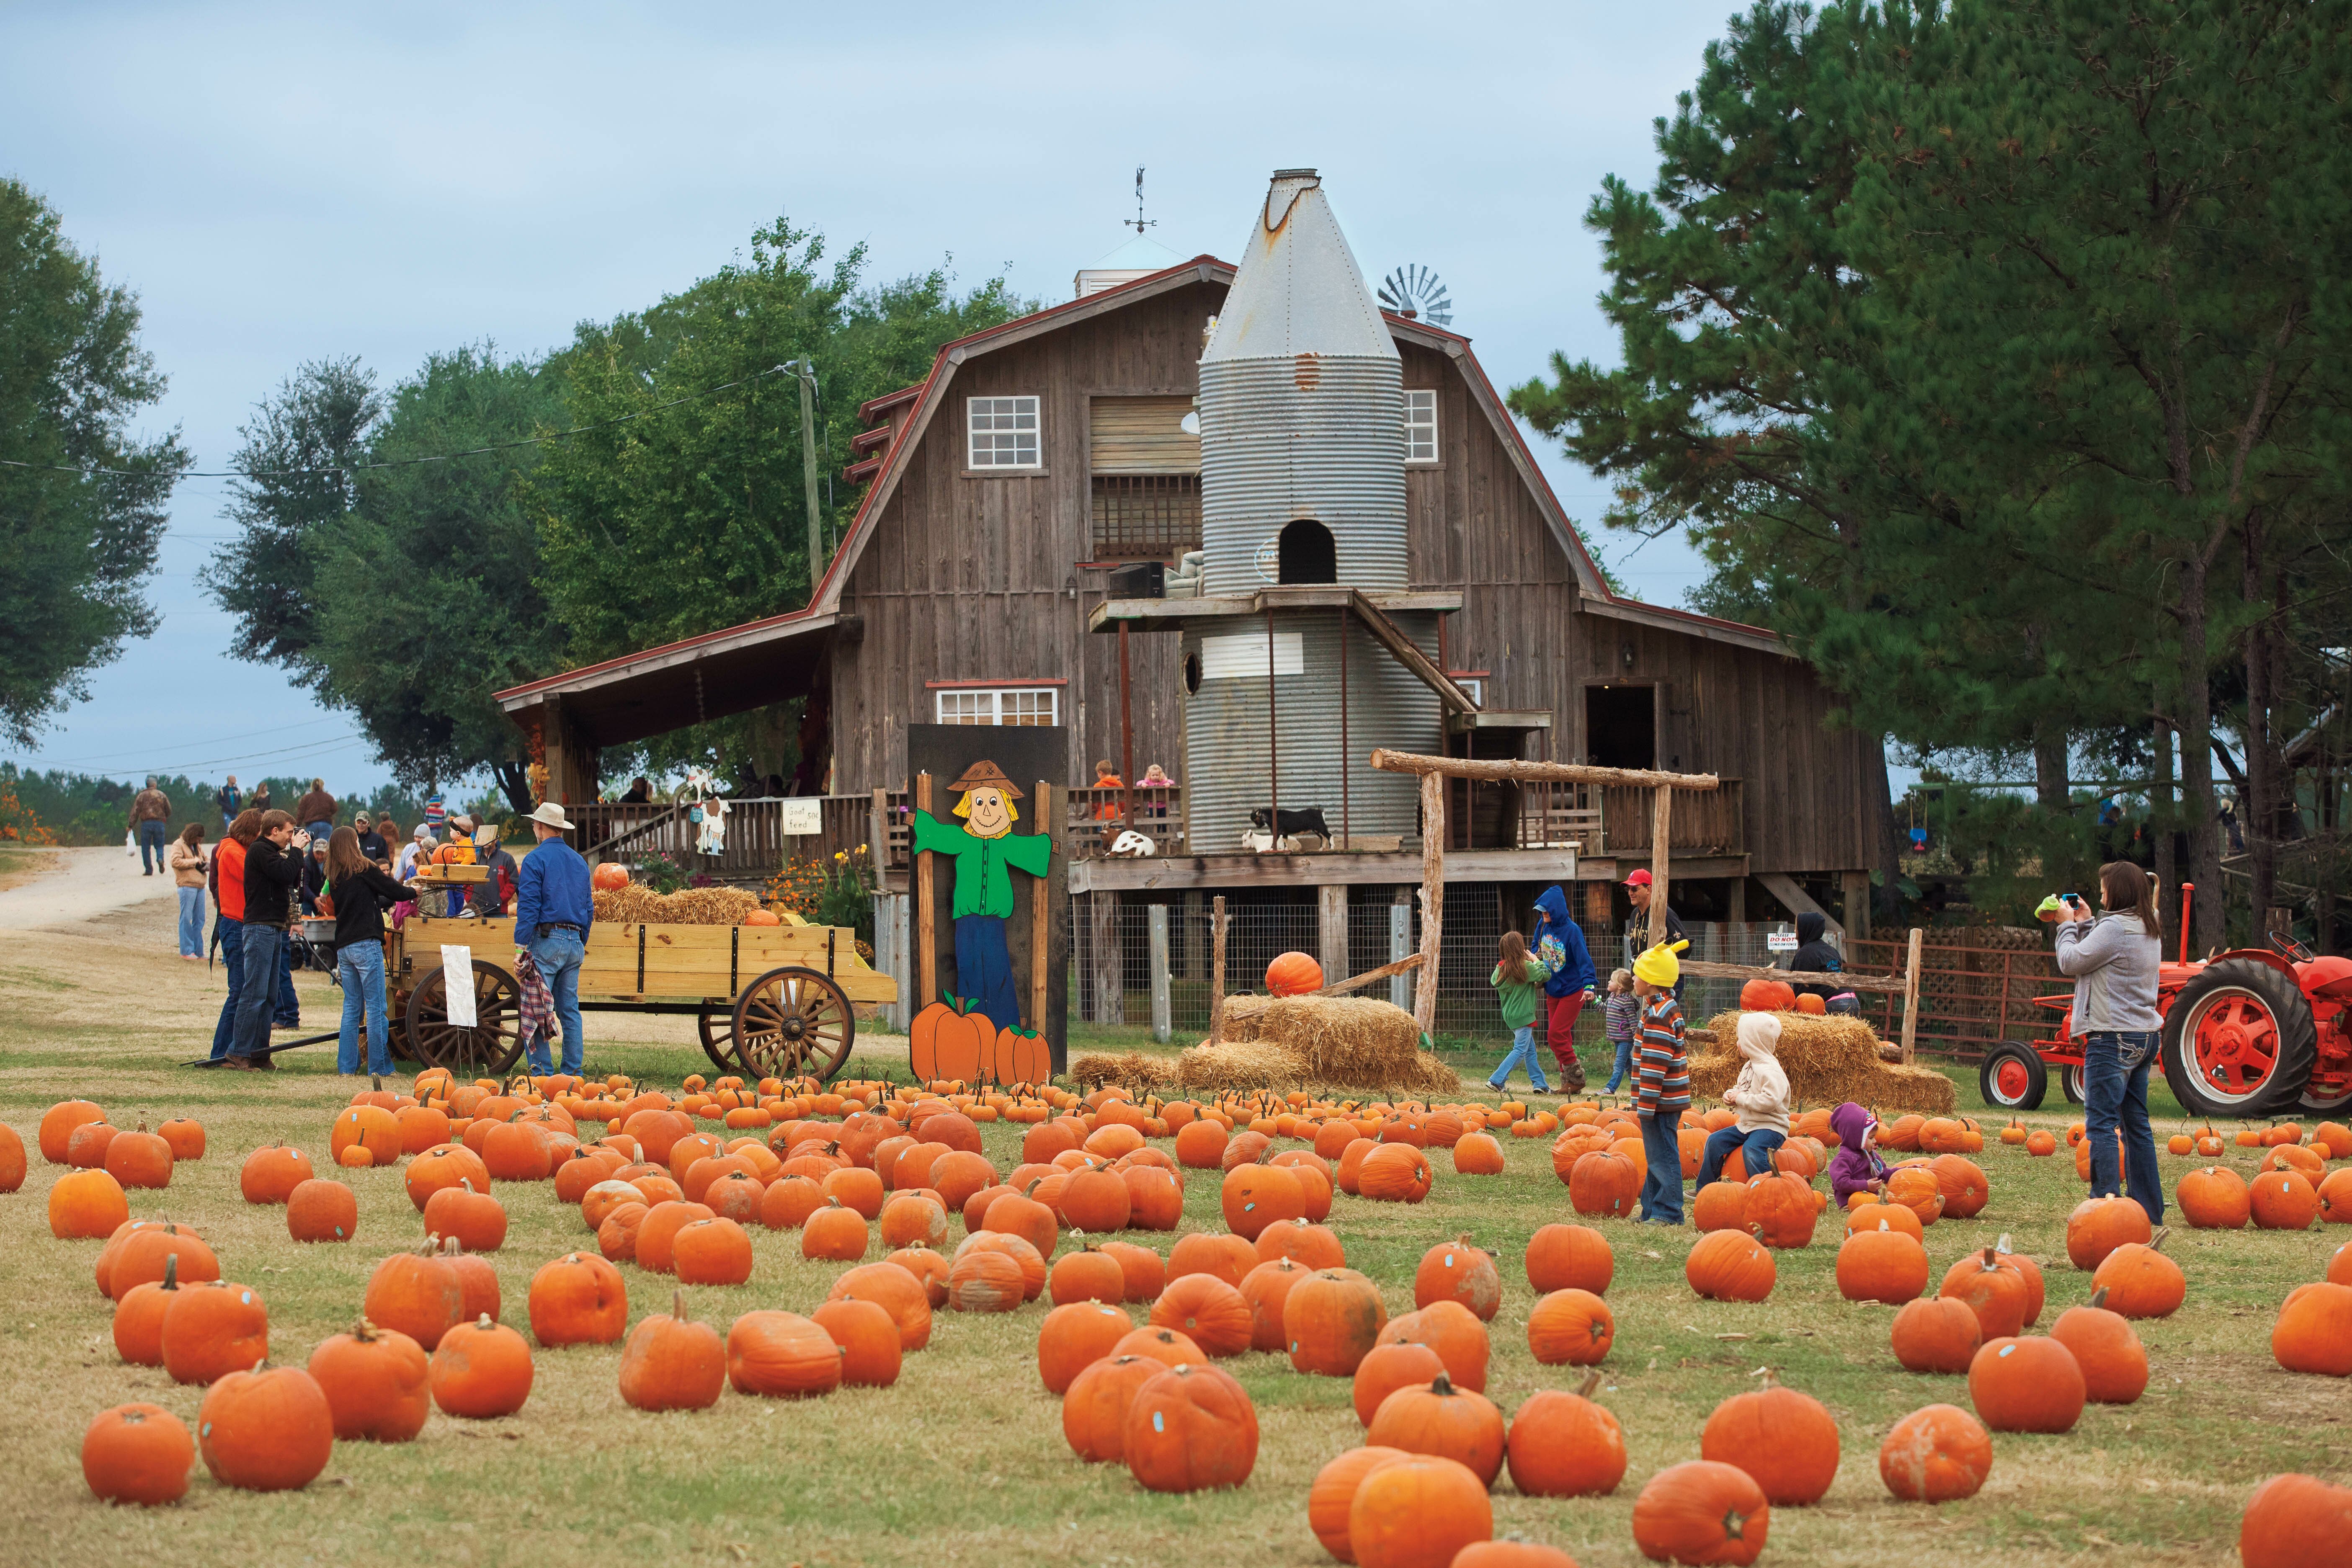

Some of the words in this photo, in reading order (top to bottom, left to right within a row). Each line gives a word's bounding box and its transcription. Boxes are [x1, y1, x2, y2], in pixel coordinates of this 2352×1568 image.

[789, 806, 805, 815] Goat
[807, 810, 819, 820] 50¢
[789, 819, 807, 828] feed
